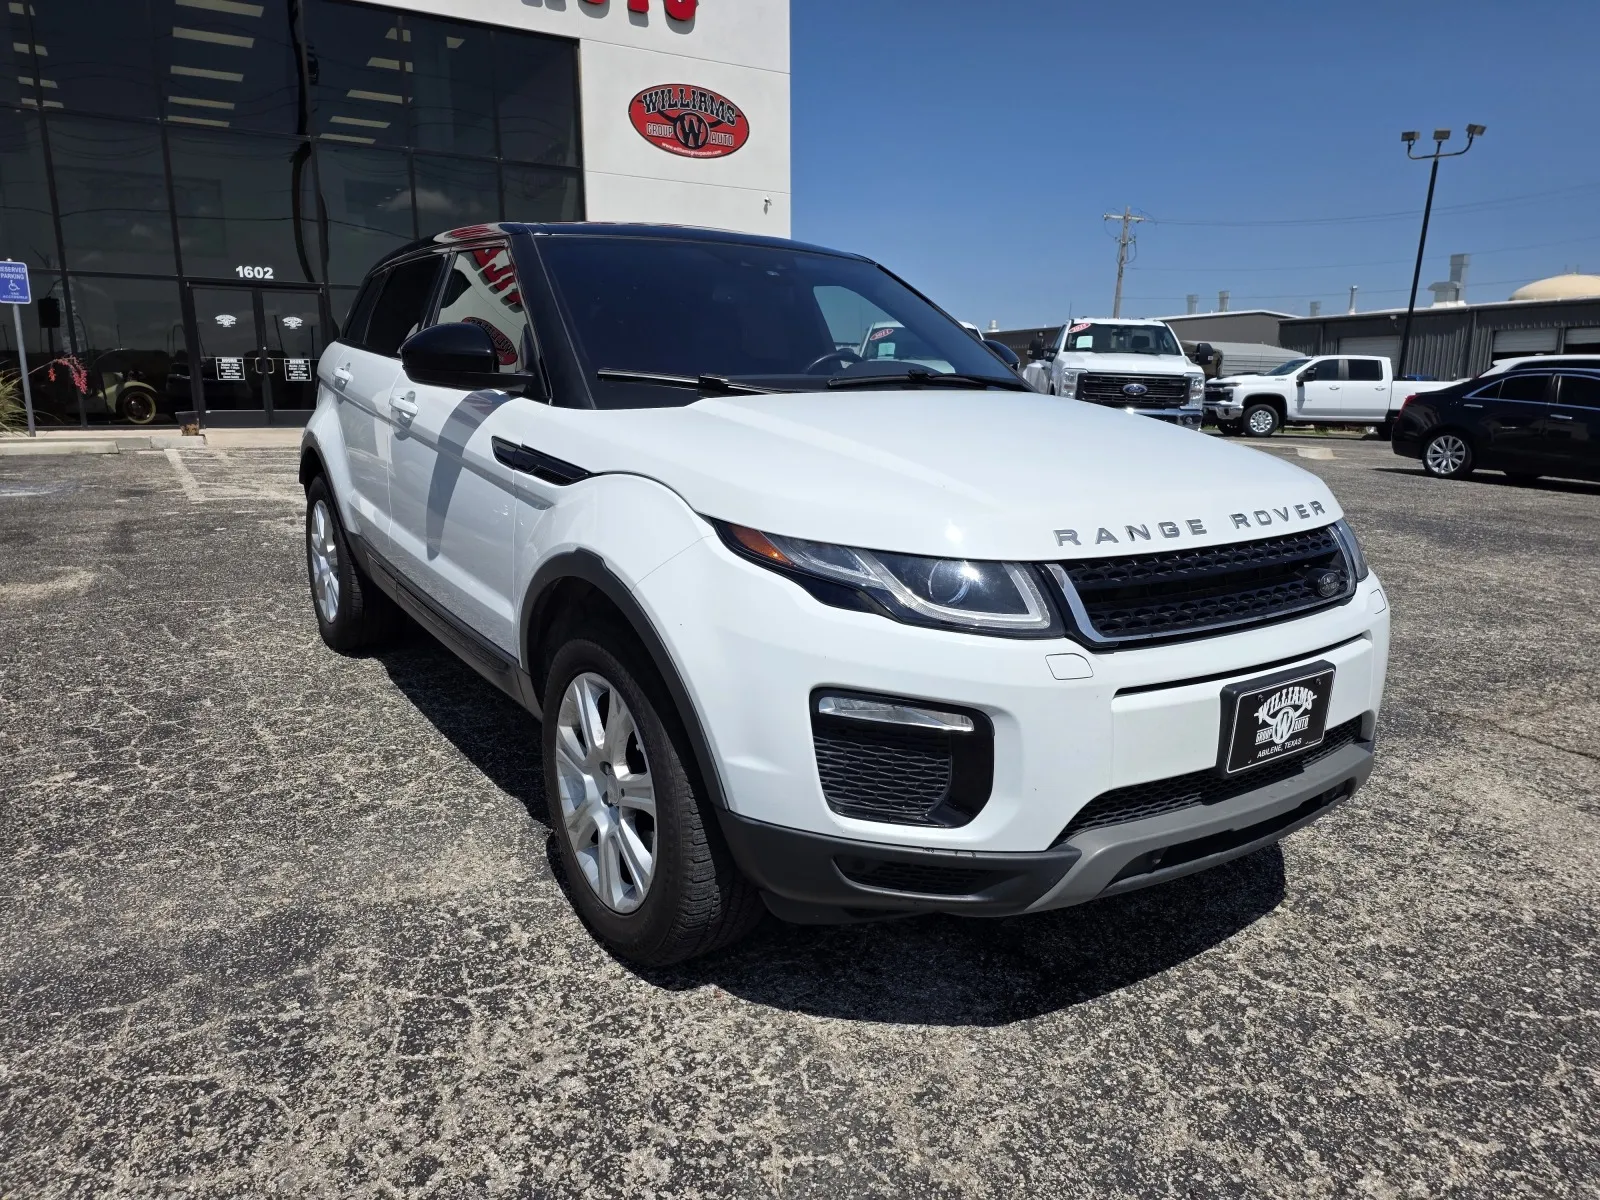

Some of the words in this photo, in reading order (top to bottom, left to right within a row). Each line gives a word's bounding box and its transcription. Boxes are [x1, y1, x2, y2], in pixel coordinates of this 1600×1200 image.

[642, 87, 736, 127] WILLIAMS
[646, 122, 674, 137] GROUP
[710, 131, 734, 147] AUTO
[0, 272, 25, 280] PARKING
[235, 265, 274, 279] 1602
[1053, 519, 1208, 547] RANGE
[1228, 500, 1326, 530] ROVER
[1257, 686, 1314, 725] WILLIAMS
[1255, 729, 1274, 743] GROUP
[1292, 717, 1309, 731] AUTO
[1256, 744, 1283, 759] ABILENE,
[1284, 737, 1302, 750] TEXAS
